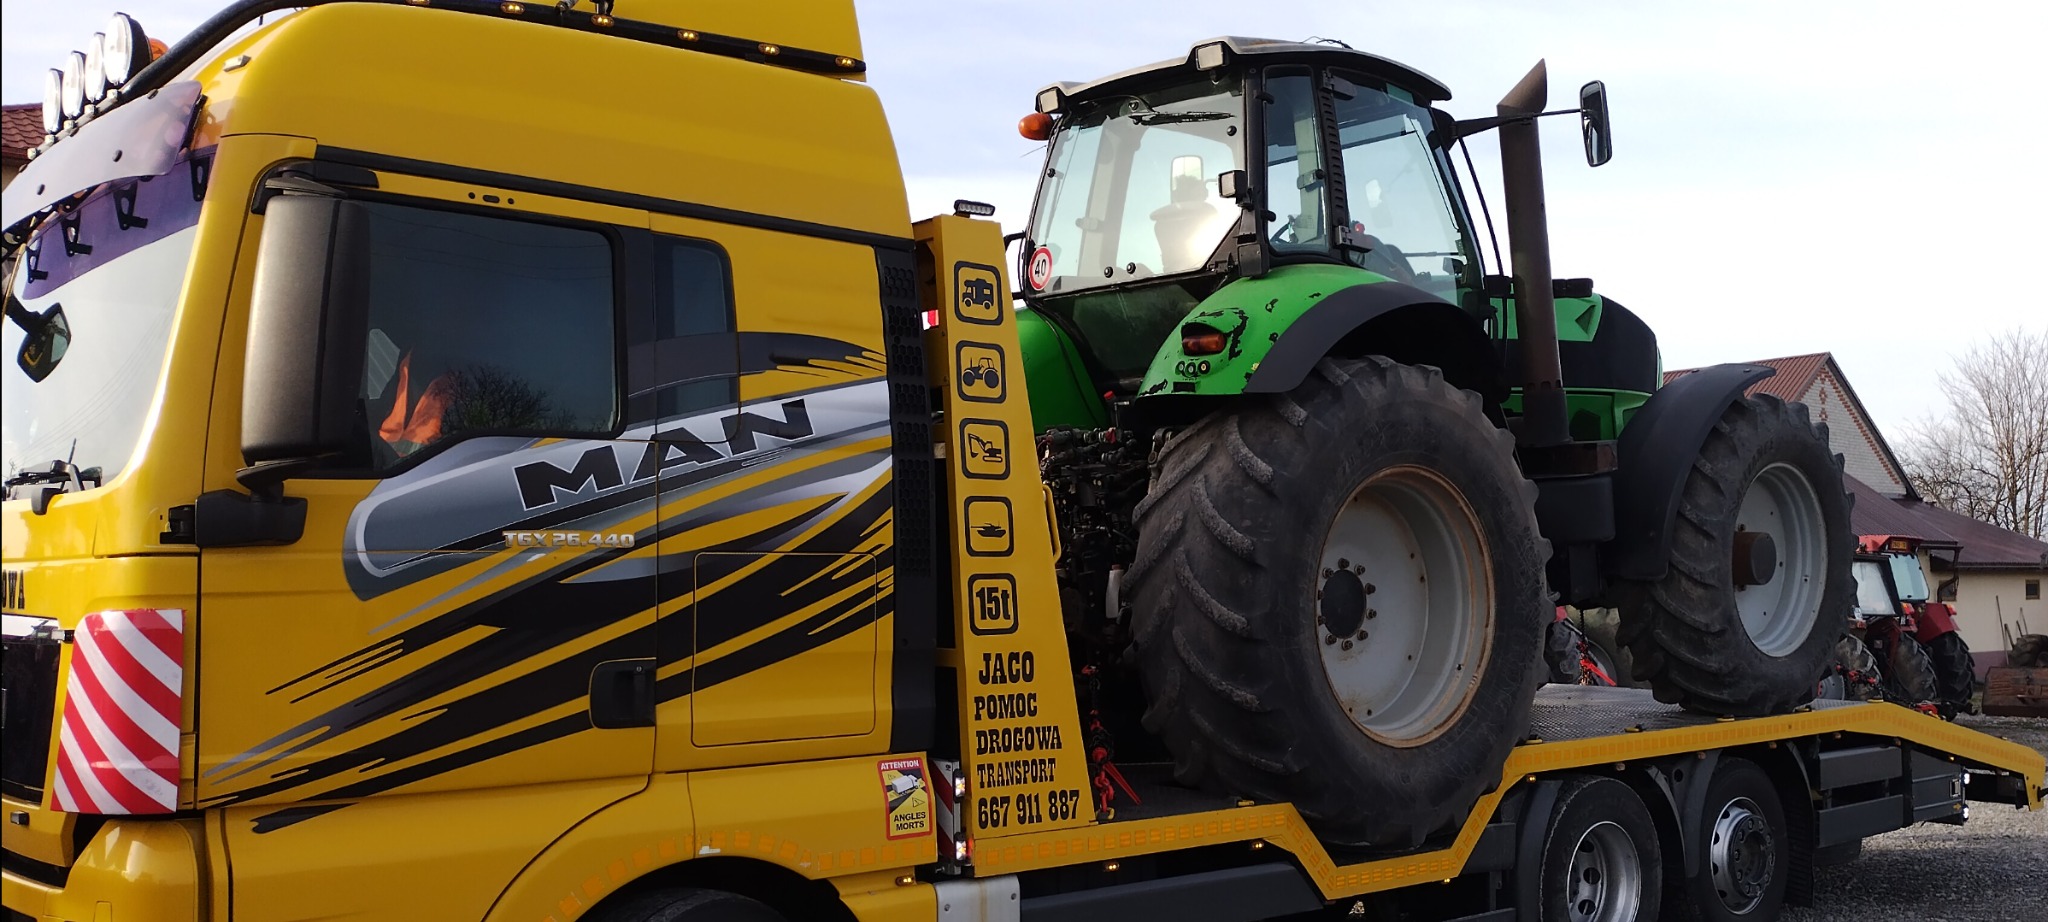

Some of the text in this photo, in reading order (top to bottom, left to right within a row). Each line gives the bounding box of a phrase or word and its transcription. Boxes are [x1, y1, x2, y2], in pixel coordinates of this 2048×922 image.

[1034, 259, 1047, 277] 40
[513, 398, 815, 511] MAN
[503, 532, 636, 548] TGX 26.440
[976, 586, 1011, 620] 15t
[978, 651, 1034, 685] JACO
[974, 692, 1038, 721] POMOC
[976, 725, 1062, 755] DROGOWA
[880, 759, 919, 770] ATTENTION
[977, 758, 1056, 788] TRANSPORT
[893, 811, 926, 823] ANGLES
[978, 790, 1079, 829] 667 911 887
[895, 821, 925, 831] MORTS
